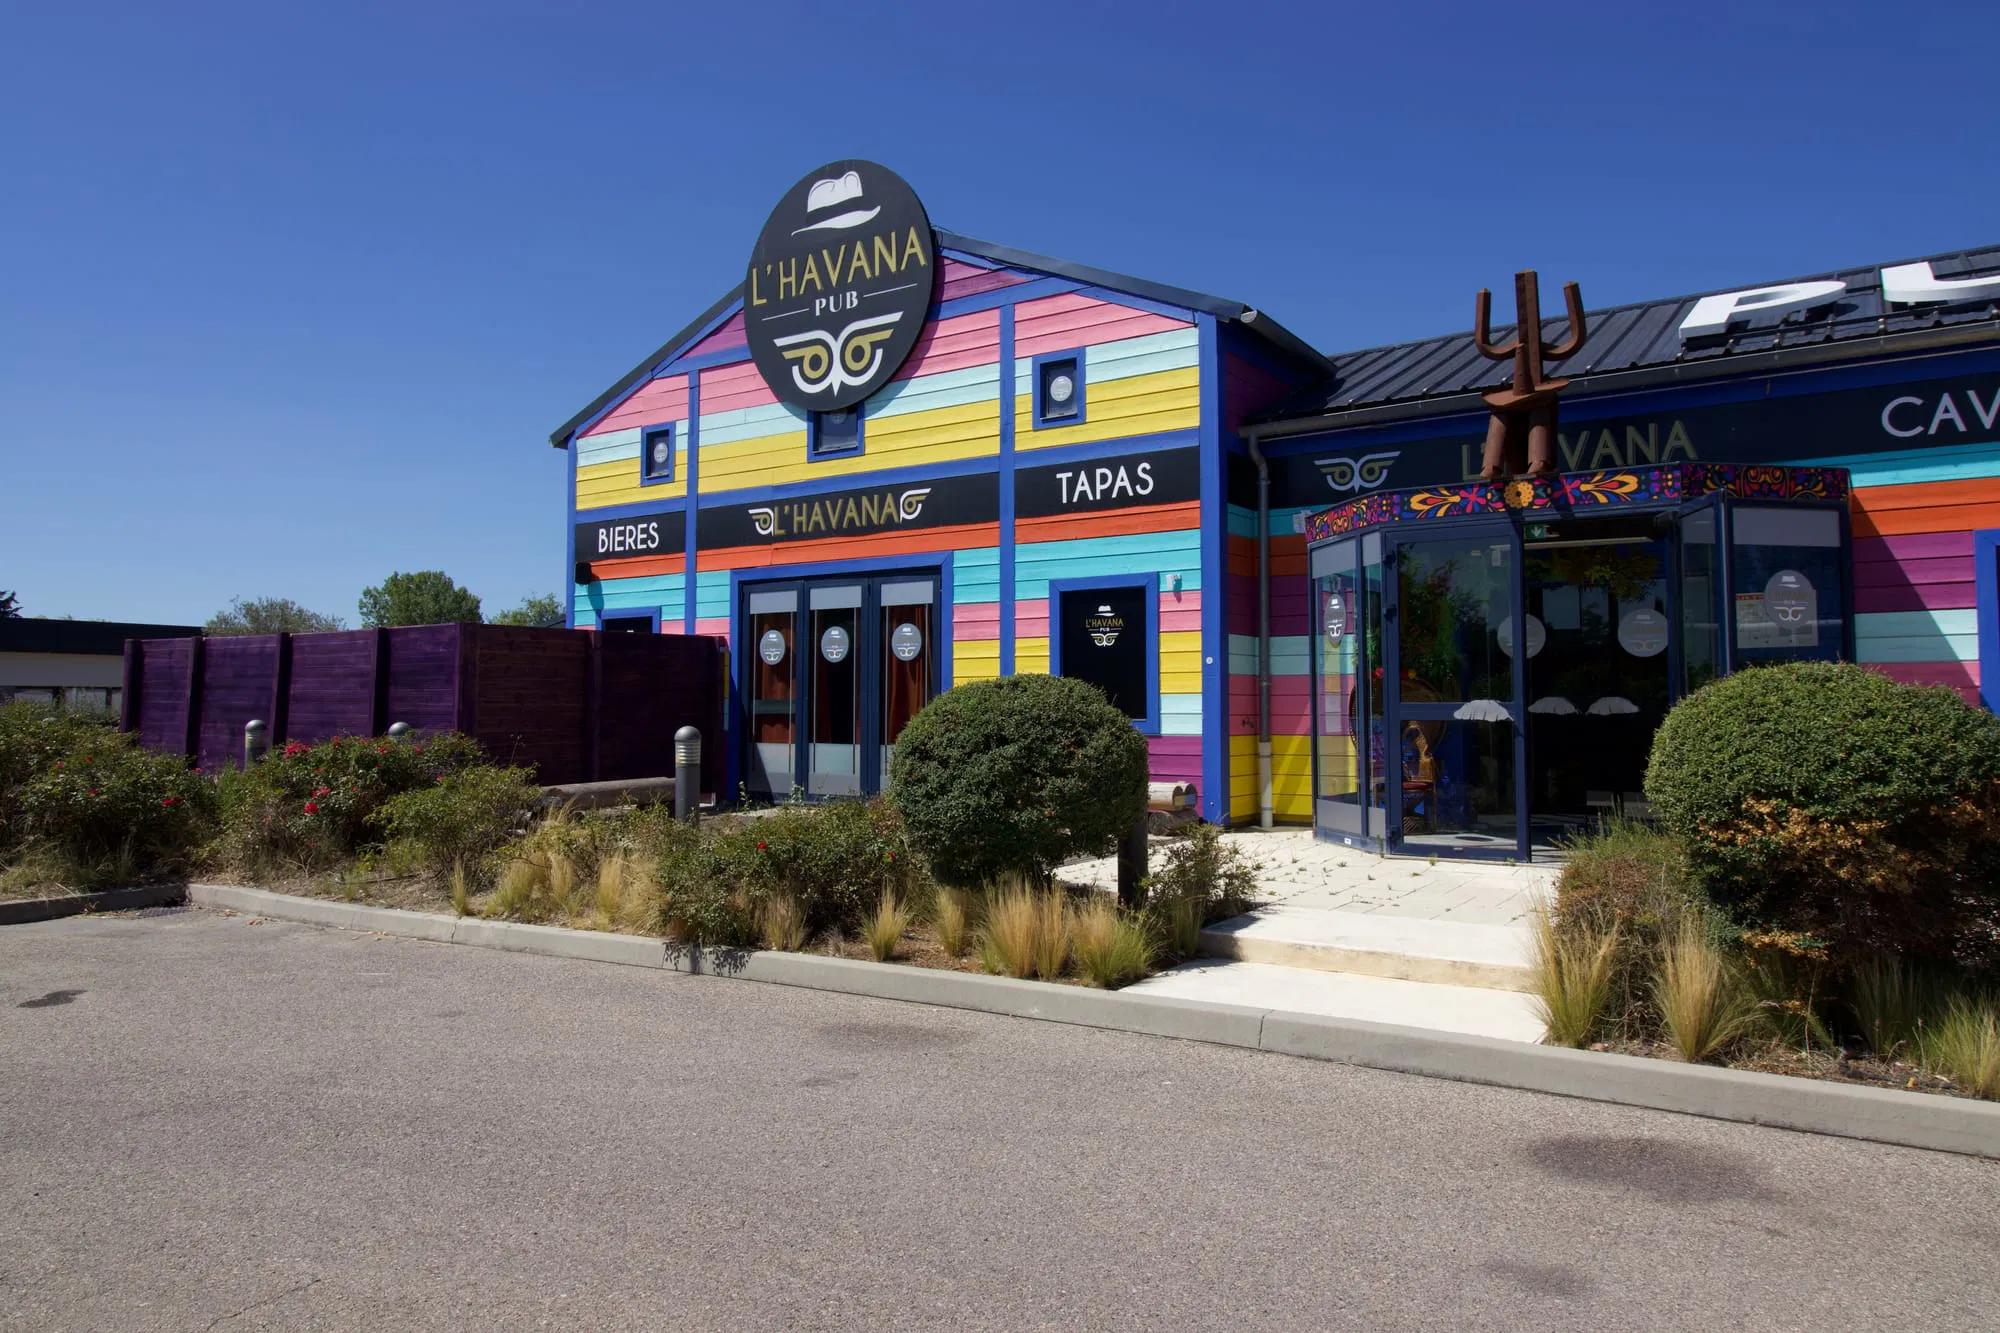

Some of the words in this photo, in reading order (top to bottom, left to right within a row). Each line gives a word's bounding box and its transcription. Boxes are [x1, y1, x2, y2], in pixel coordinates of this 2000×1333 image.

[752, 225, 928, 306] L'HAVANA
[815, 290, 859, 317] PUB
[1881, 387, 2000, 438] CAV
[1461, 420, 1698, 481] L'VANA
[1055, 462, 1154, 504] TAPAS
[597, 521, 660, 553] BIERES
[774, 493, 901, 537] L'HAVANA
